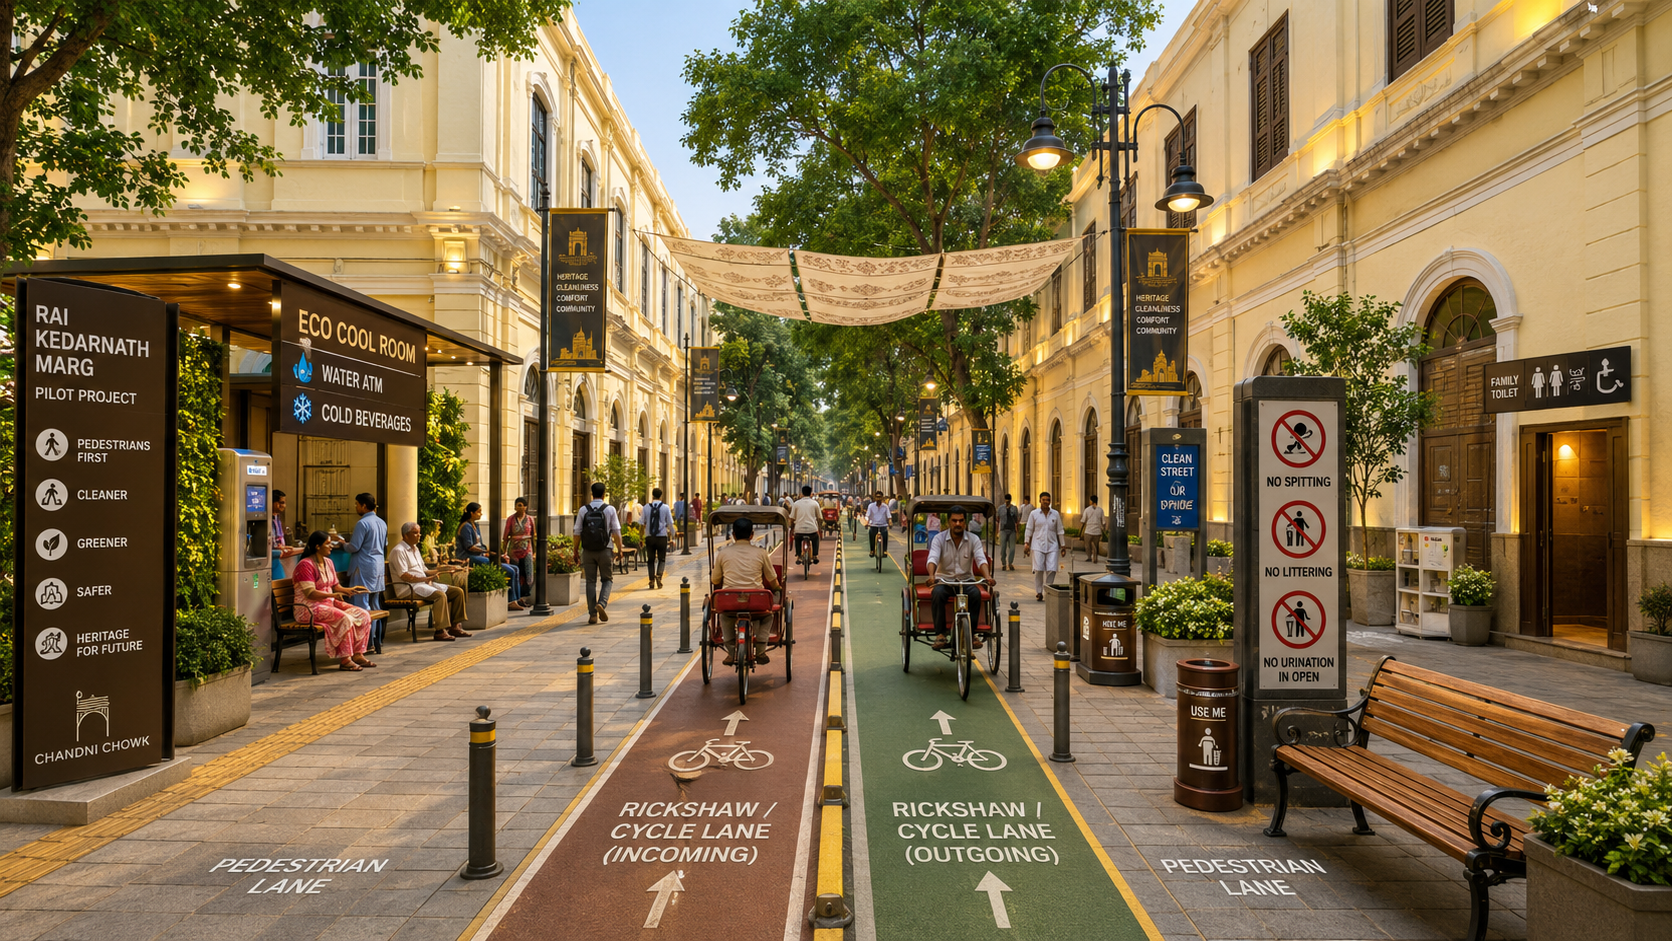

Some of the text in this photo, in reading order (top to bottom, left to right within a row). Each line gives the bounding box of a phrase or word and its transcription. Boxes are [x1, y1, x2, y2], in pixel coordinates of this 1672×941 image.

[1135, 294, 1170, 302] HERITAGE
[35, 304, 69, 327] RAI
[35, 328, 150, 358] KEDARNATH
[299, 308, 416, 364] ECO COOL ROOM
[35, 354, 94, 377] MARG
[321, 364, 383, 394] WATER ATM
[1491, 375, 1519, 387] FAMILY
[35, 386, 137, 405] PILOT PROJECT
[1491, 388, 1519, 399] TOILET
[321, 403, 412, 433] COLD BEVERAGES
[77, 438, 151, 451] PEDESTRIANS
[77, 452, 108, 463] FIRST
[1161, 453, 1193, 464] CLEAN
[1160, 466, 1195, 477] STREET
[1266, 476, 1331, 487] NO SPITTING
[77, 489, 128, 501] CLEANER
[77, 537, 128, 549] GREENER
[1264, 566, 1333, 578] NO LITTERING
[76, 585, 112, 598] SAFER
[76, 628, 130, 644] HERITAGE
[76, 640, 143, 658] FOR FUTURE
[1263, 657, 1334, 668] NO URINATION
[1278, 671, 1320, 682] IN OPEN
[1190, 704, 1227, 718] USE ME
[34, 735, 150, 766] CHANDNI CHOWK
[618, 801, 760, 818] RICKSHAW
[892, 801, 1026, 818] RICKSHAW
[610, 823, 772, 840] CYCLE LANE
[897, 823, 1056, 840] CYCLE LANE
[602, 845, 759, 866] (INCOMING)
[904, 845, 1060, 866] (OUTGOING)
[208, 858, 390, 873] PEDESTRIAN
[1160, 859, 1328, 874] PEDESTRIAN
[246, 878, 333, 894] LANE
[1219, 879, 1296, 896] LANE
